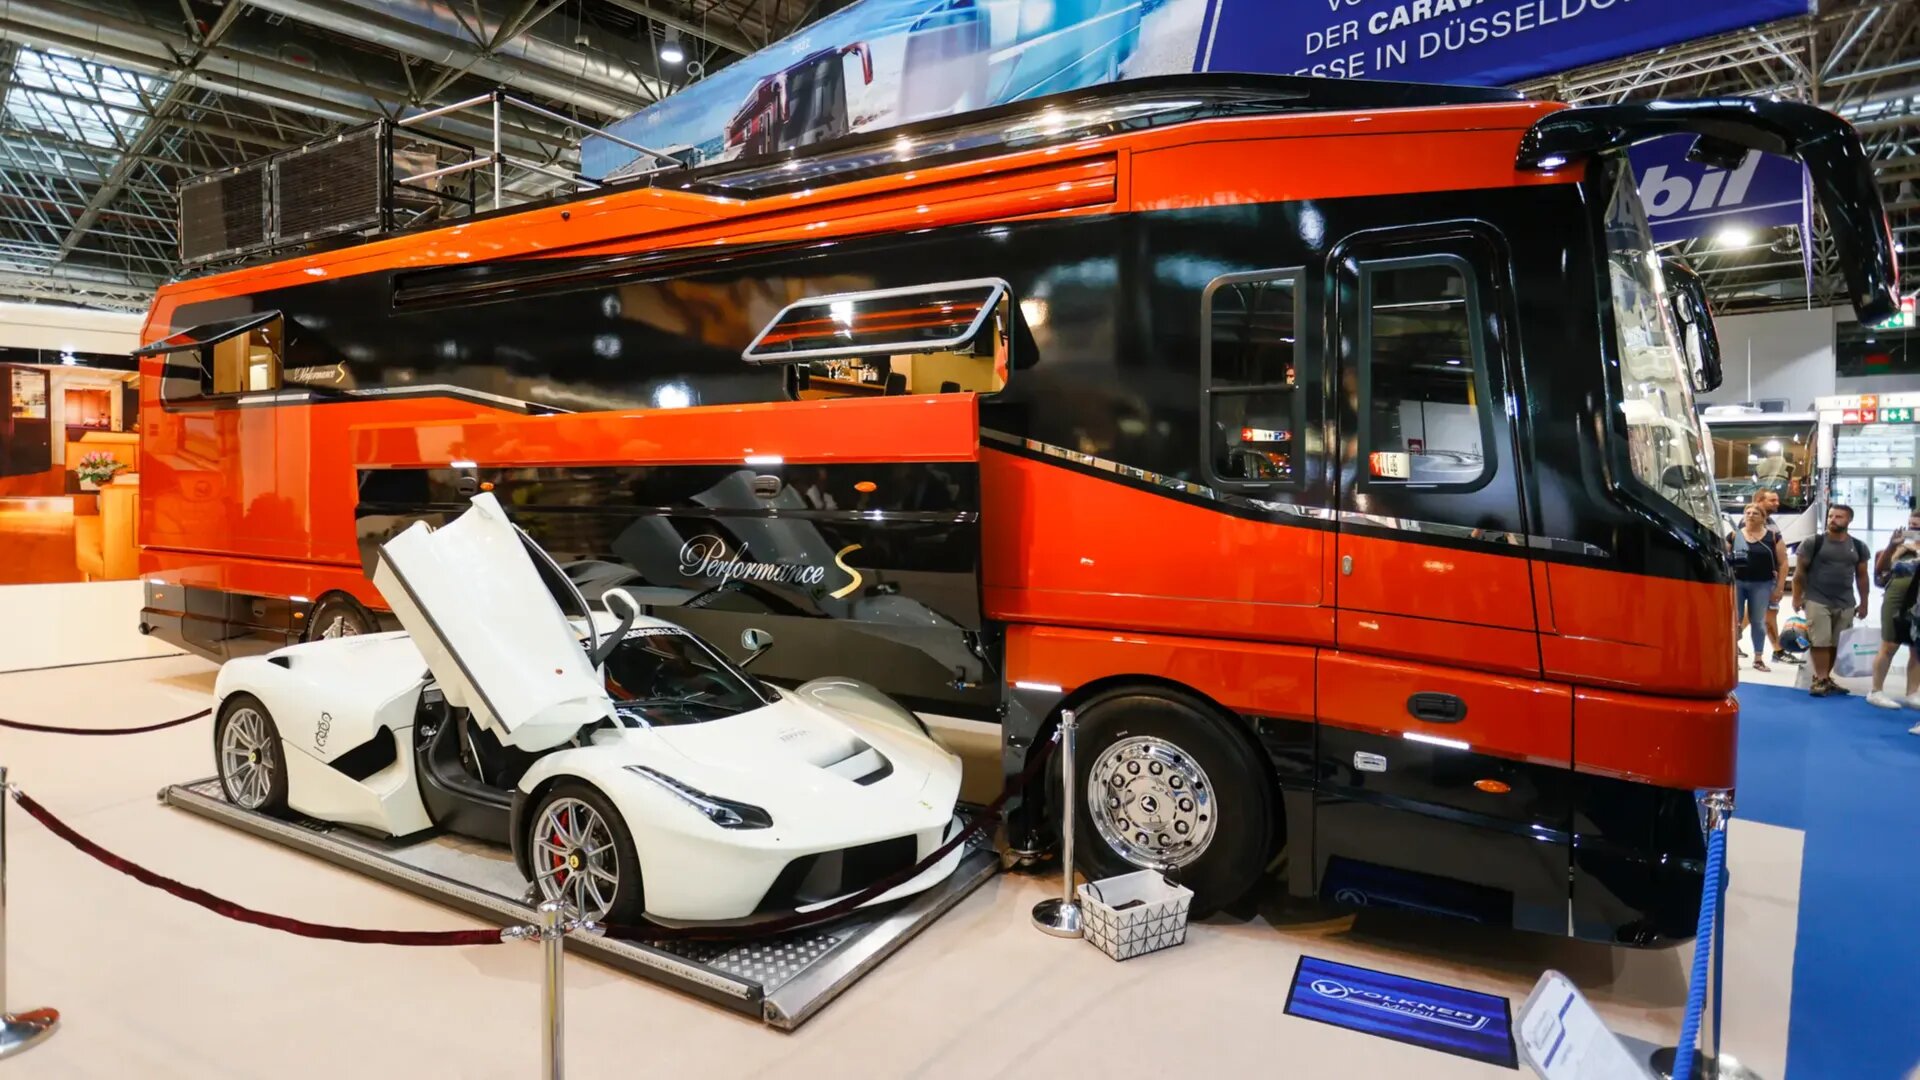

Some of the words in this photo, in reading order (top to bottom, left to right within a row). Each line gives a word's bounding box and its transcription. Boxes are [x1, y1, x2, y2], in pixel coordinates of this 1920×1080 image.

[1306, 20, 1359, 55] DER
[1368, 0, 1485, 35] CARA
[1376, 40, 1406, 70] IN
[1420, 0, 1631, 58] DÜSSELD
[679, 534, 825, 592] Performance
[829, 543, 863, 599] S
[1349, 987, 1474, 1020] VOLKNER
[1381, 1002, 1434, 1018] Mobil
